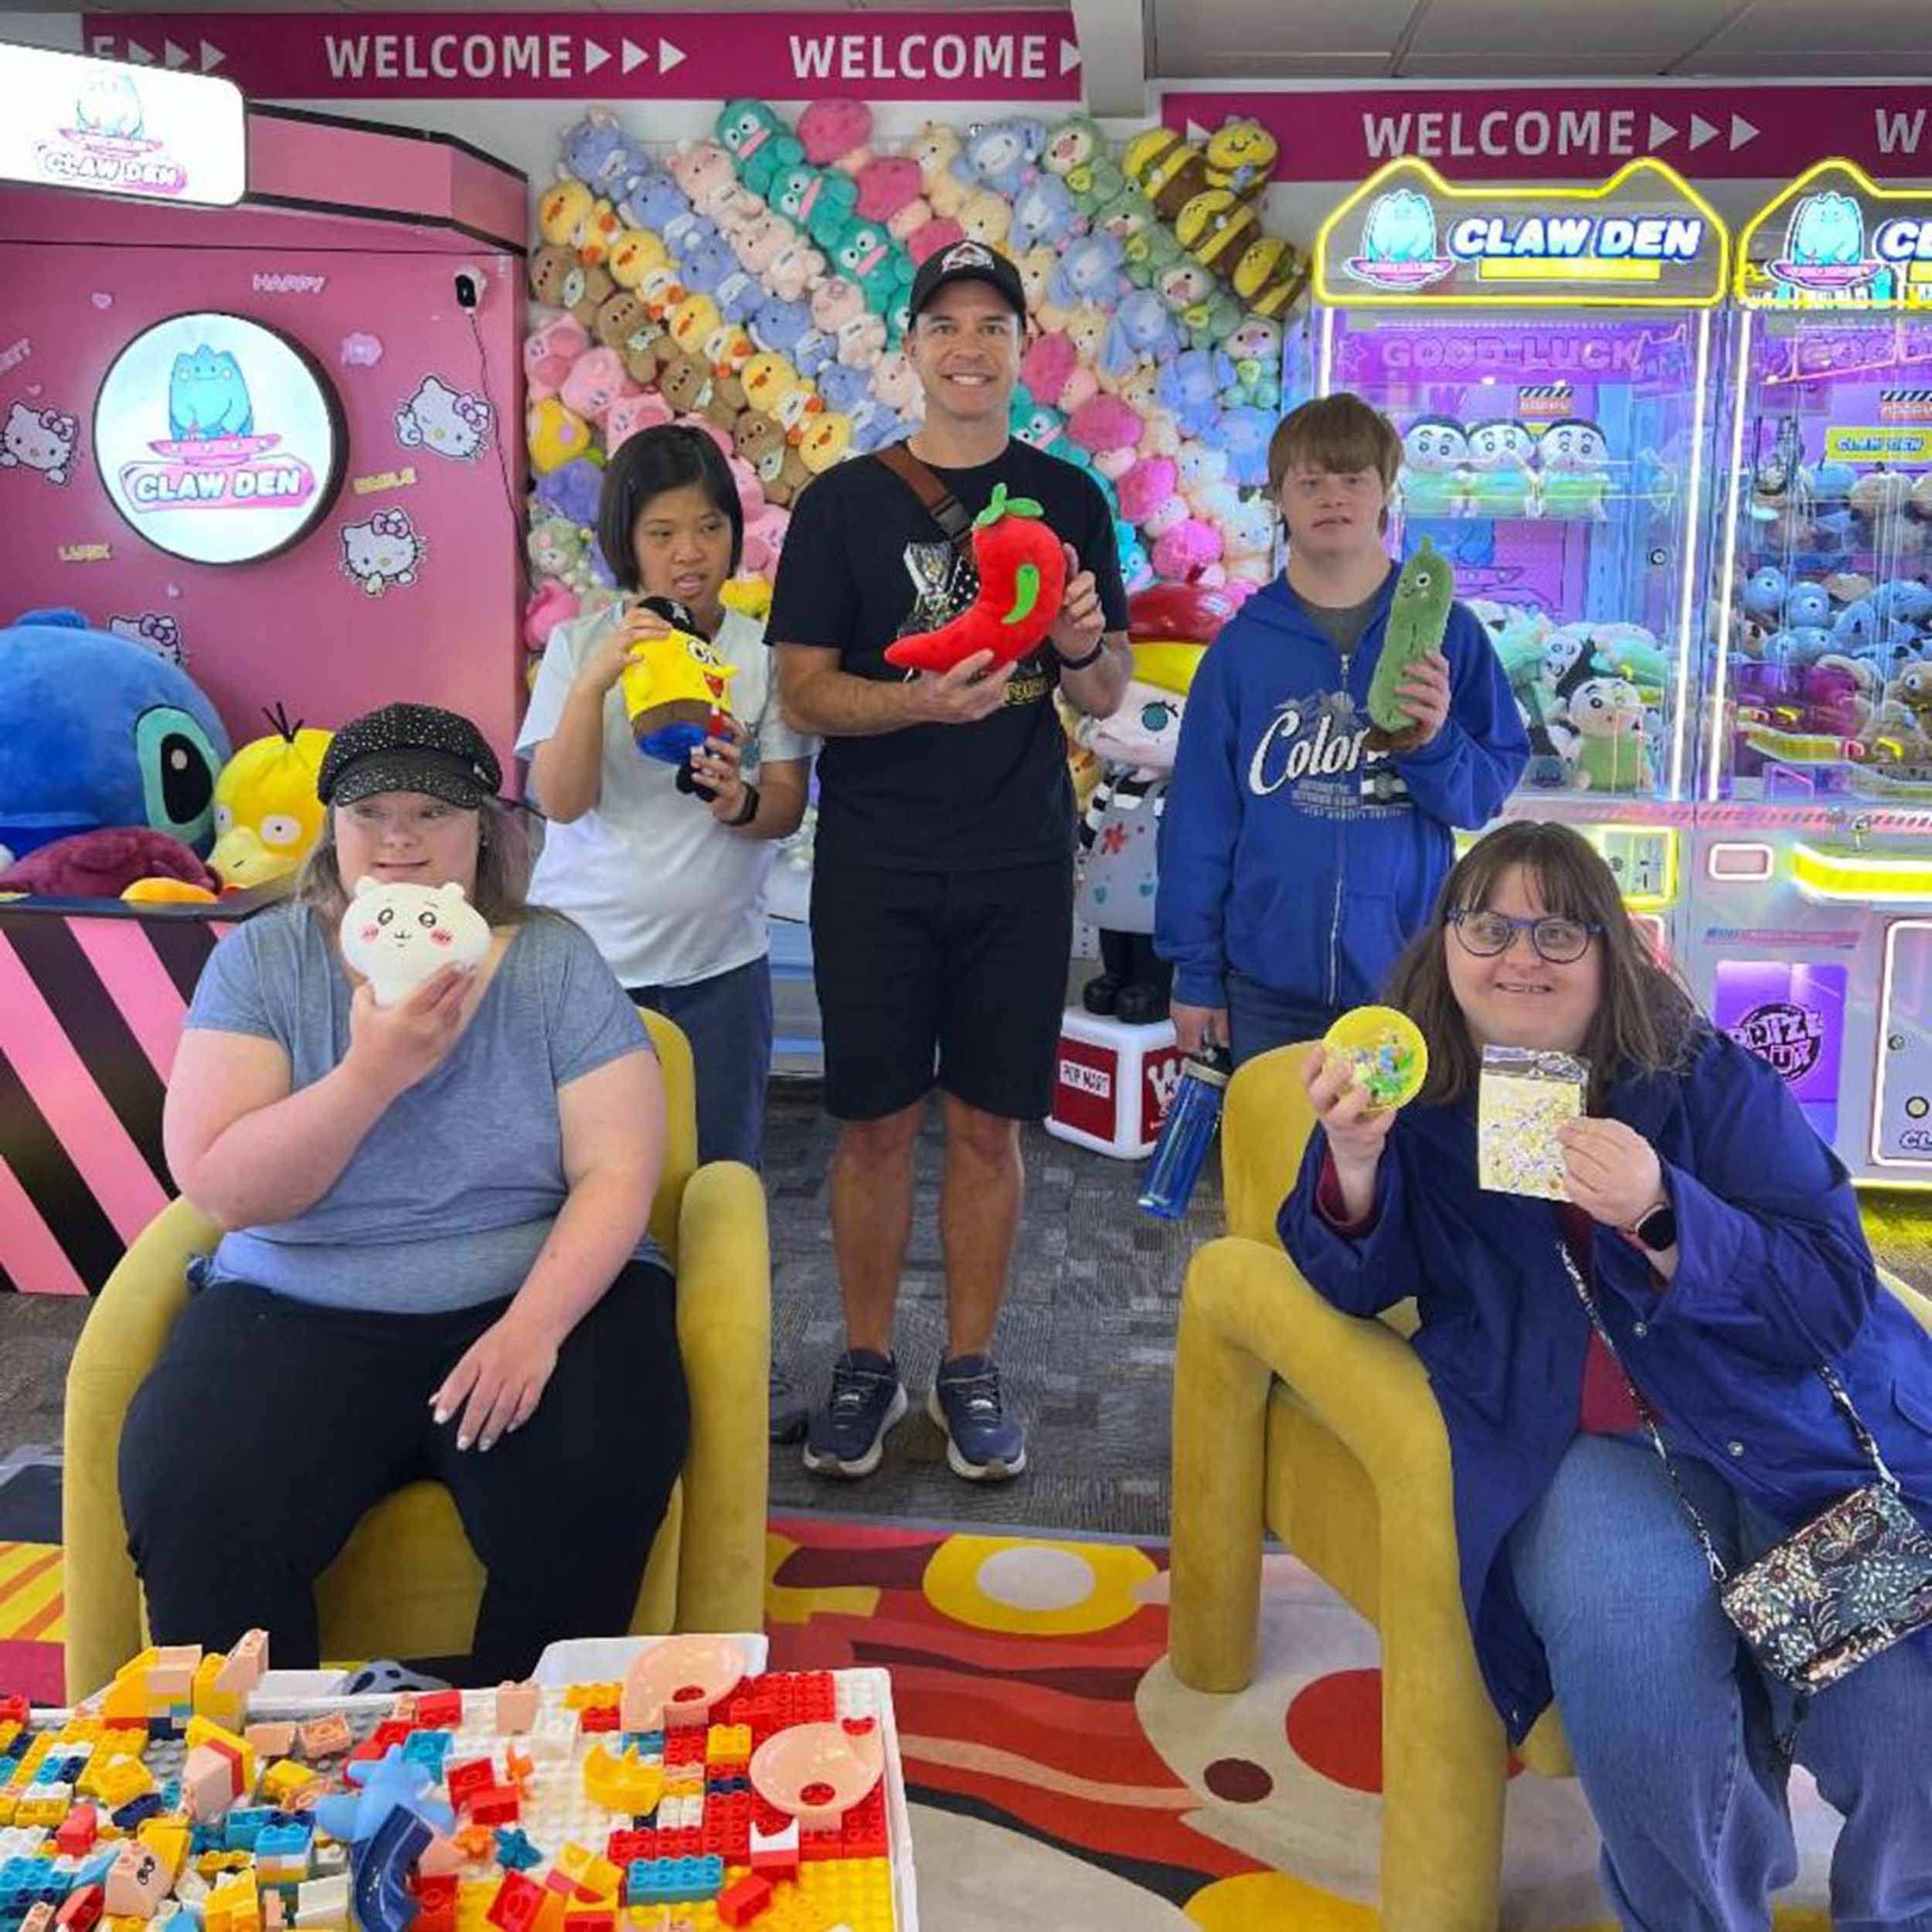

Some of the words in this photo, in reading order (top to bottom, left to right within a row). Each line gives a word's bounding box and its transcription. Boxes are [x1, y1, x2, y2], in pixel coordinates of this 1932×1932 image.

[325, 35, 571, 78] WELCOME
[790, 35, 1046, 79] WELCOME
[1362, 110, 1636, 157] WELCOME
[1449, 216, 1594, 259] CLAW
[1595, 216, 1705, 260] DEN
[136, 470, 227, 502] CLAW
[234, 467, 302, 498] DEN
